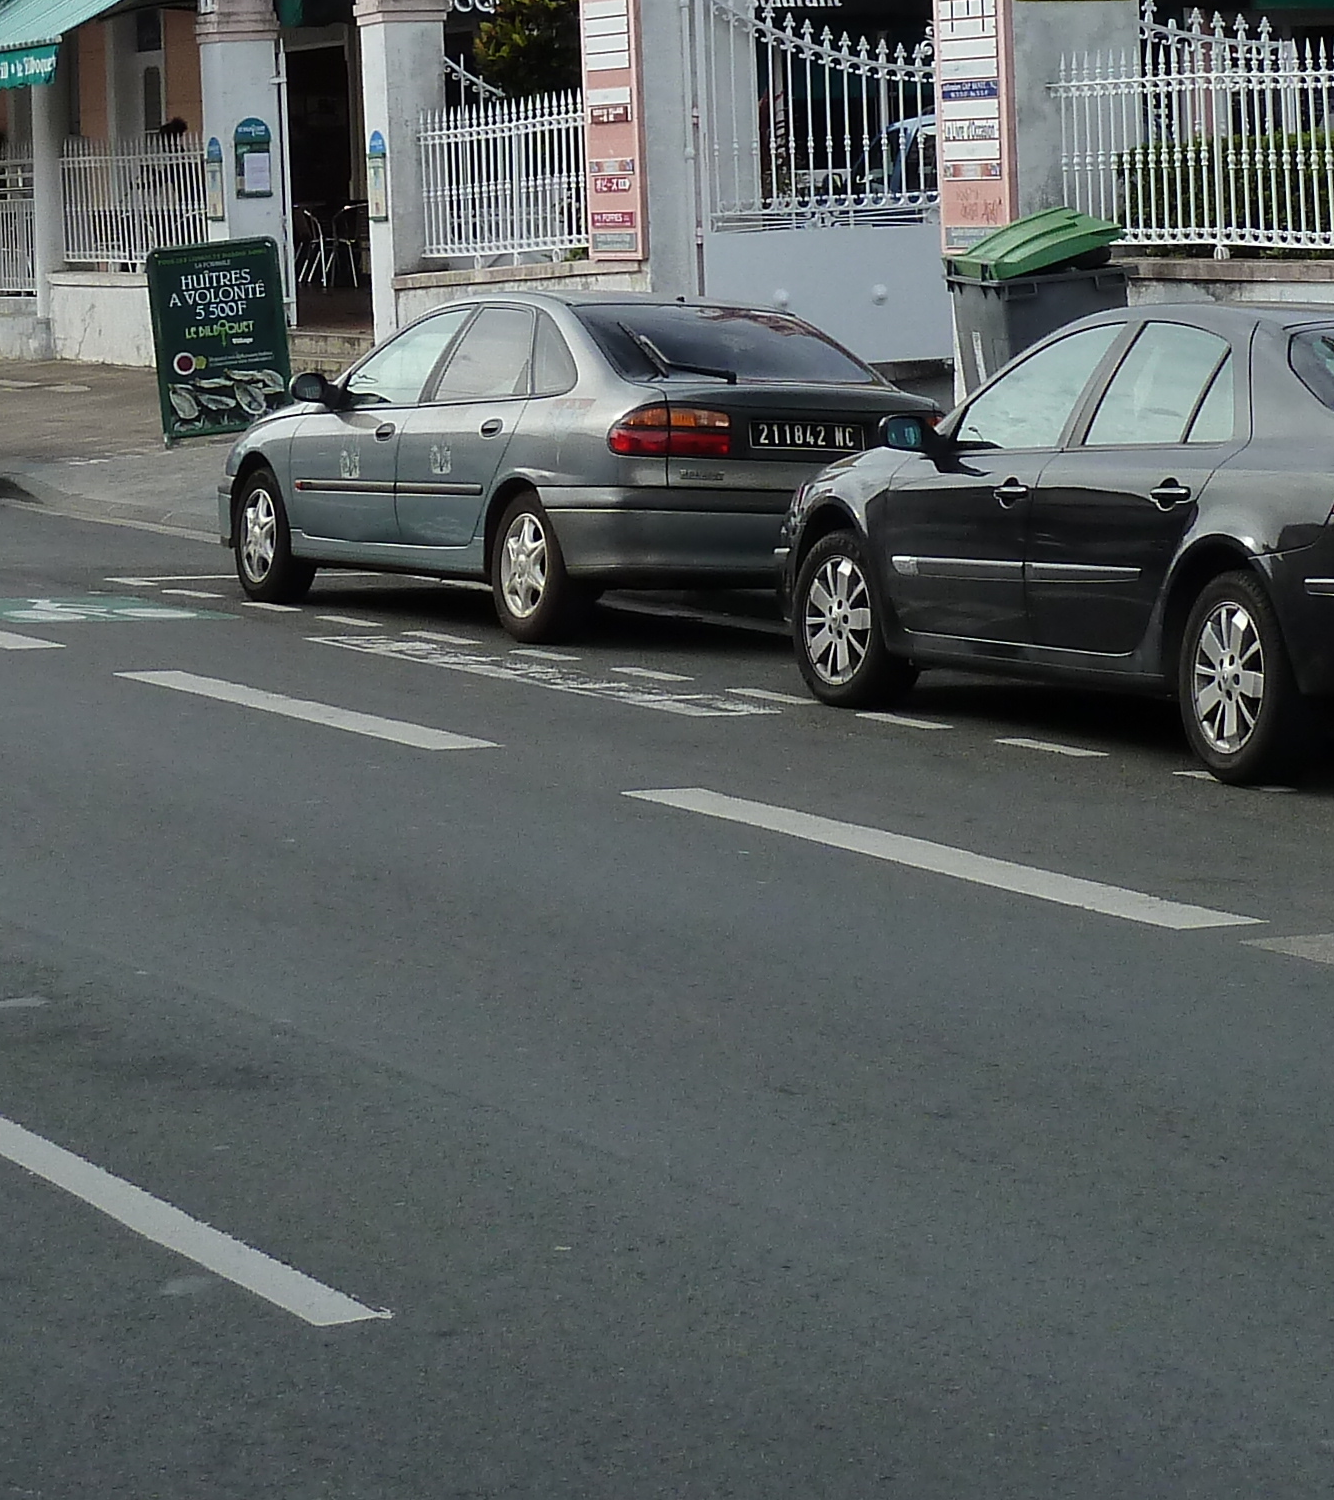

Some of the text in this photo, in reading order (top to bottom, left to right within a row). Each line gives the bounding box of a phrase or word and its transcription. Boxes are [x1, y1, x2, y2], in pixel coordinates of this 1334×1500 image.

[181, 268, 251, 291] HUÎTRES
[169, 280, 266, 307] A VOLONTÉ
[195, 300, 247, 320] 5 500F
[758, 424, 855, 447] 211842 NC
